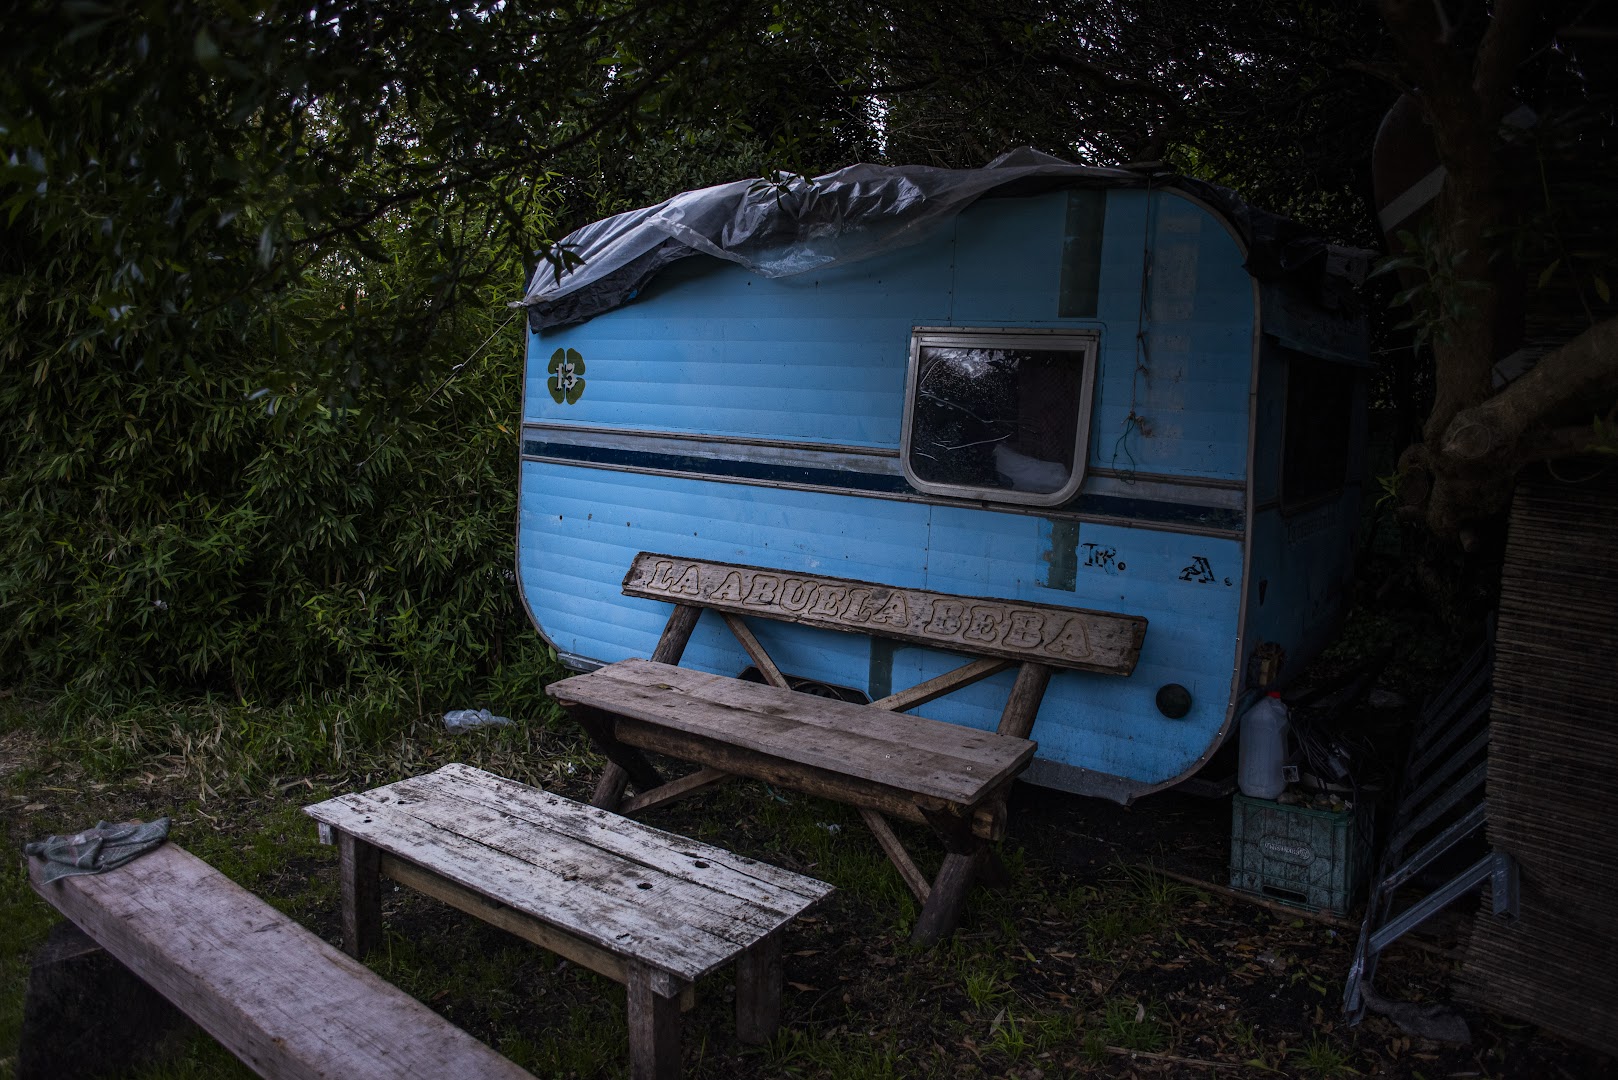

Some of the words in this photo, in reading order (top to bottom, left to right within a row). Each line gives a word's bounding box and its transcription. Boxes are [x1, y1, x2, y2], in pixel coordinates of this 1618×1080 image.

[555, 362, 579, 392] 13
[646, 560, 700, 595] LA
[710, 571, 911, 628] ABUELA
[923, 597, 1094, 659] BEBA
